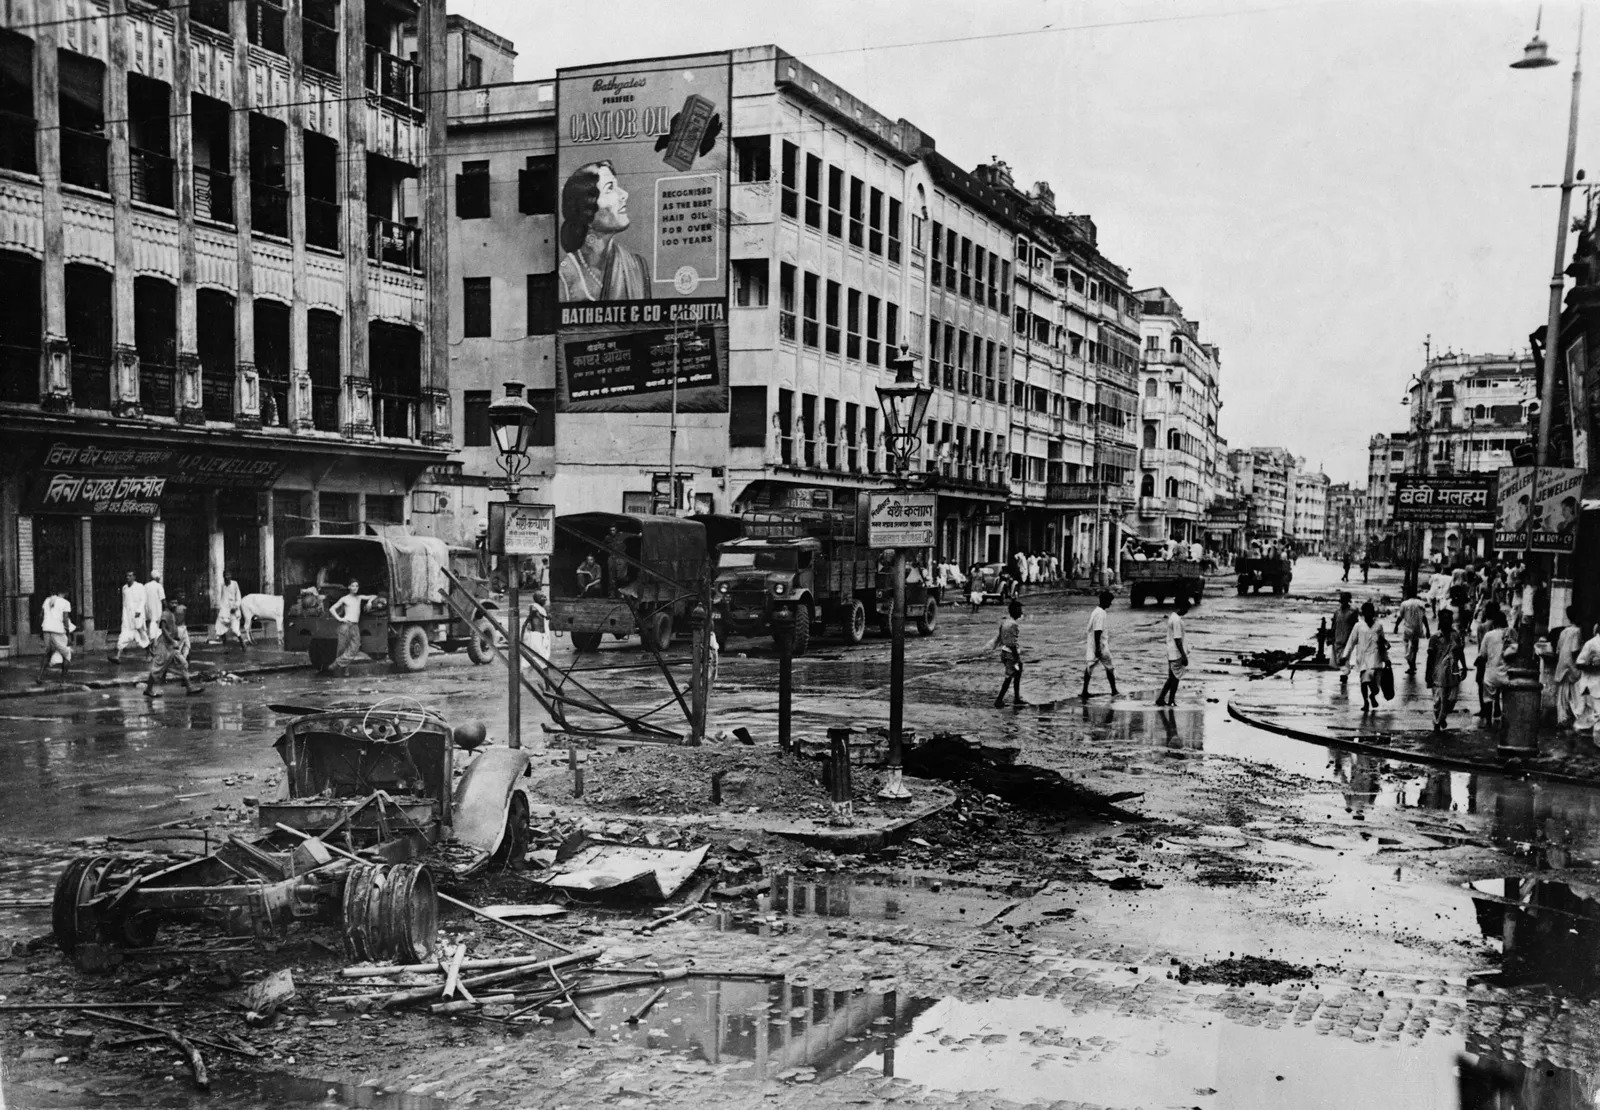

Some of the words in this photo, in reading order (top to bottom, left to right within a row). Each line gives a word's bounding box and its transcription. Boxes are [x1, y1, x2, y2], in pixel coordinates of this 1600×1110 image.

[570, 108, 638, 142] CASTOR
[643, 105, 670, 136] OIL
[662, 187, 713, 198] RECOGNISED
[676, 201, 691, 209] THE
[693, 200, 713, 208] BEST
[662, 214, 684, 223] HAIR
[691, 212, 708, 220] OIL
[662, 226, 682, 234] FOR
[687, 223, 712, 232] OVER
[662, 238, 680, 246] 100
[682, 235, 713, 245] YEARS
[561, 306, 627, 325] BATHGATE
[630, 306, 641, 322] &
[669, 303, 724, 321] CALCUTTA
[43, 473, 85, 503] বিনা
[1399, 484, 1435, 505] बेबी
[1437, 489, 1488, 507] मलहम
